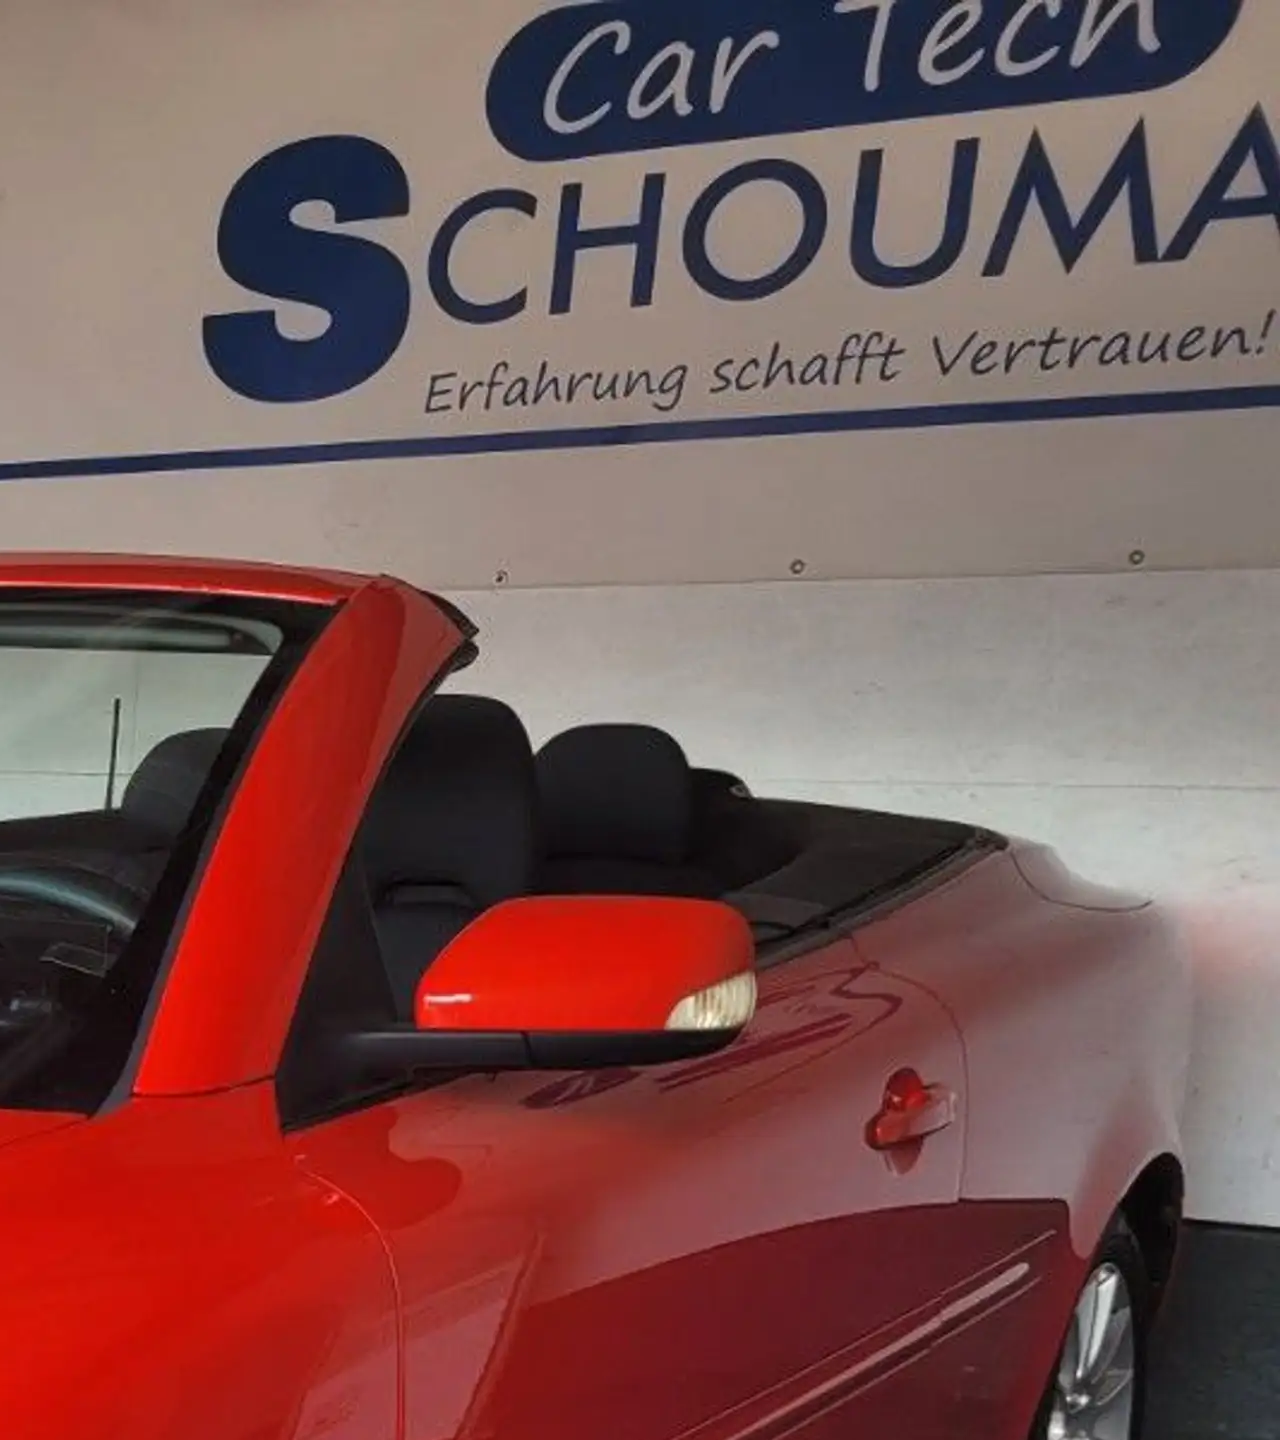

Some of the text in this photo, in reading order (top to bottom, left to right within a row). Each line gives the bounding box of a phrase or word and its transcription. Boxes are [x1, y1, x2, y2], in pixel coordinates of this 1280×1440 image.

[542, 0, 1162, 135] Car Tech
[425, 309, 1277, 414] Erfahrung schafft Vertrauen!
